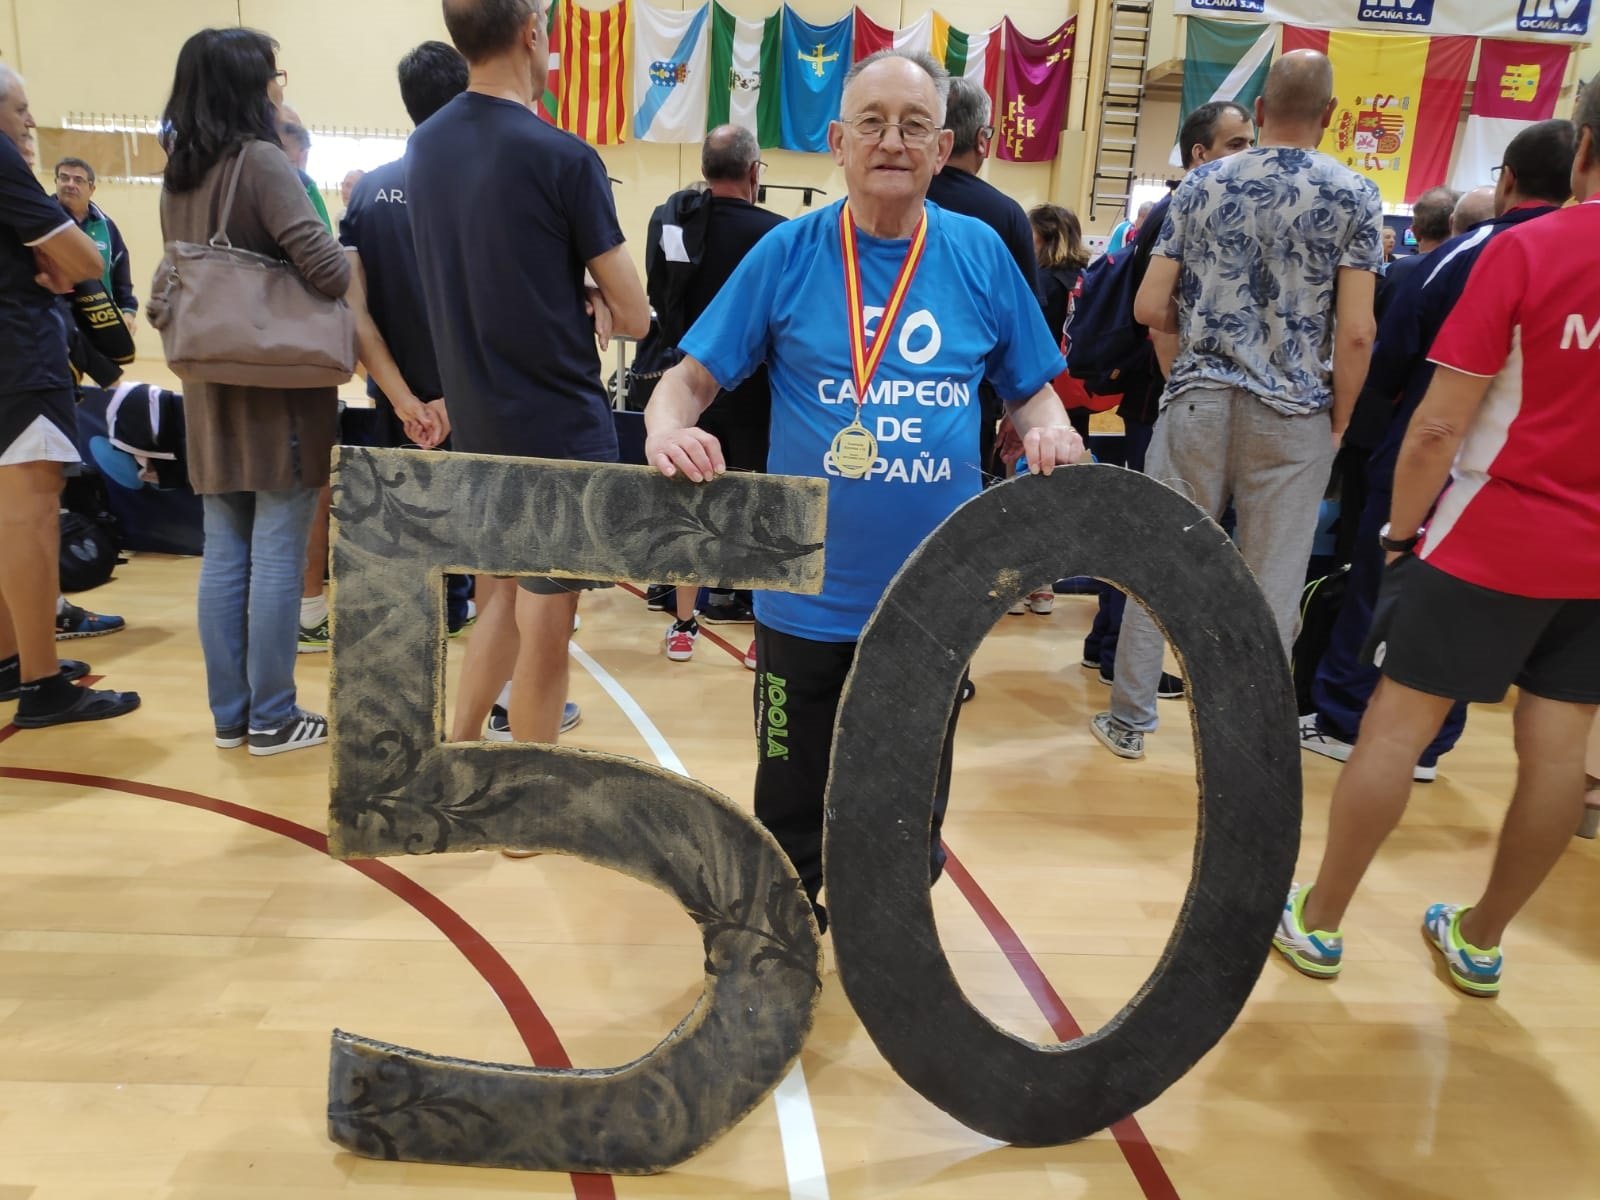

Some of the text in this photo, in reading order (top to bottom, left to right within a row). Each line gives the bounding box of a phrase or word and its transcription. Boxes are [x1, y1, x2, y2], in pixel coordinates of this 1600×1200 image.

[1362, 9, 1426, 22] OCAÑA S.A.
[374, 188, 408, 204] AR
[817, 376, 970, 408] CAMPEÓN
[876, 416, 922, 443] DE
[823, 451, 953, 484] EPAÑA
[766, 672, 789, 758] JOOLA
